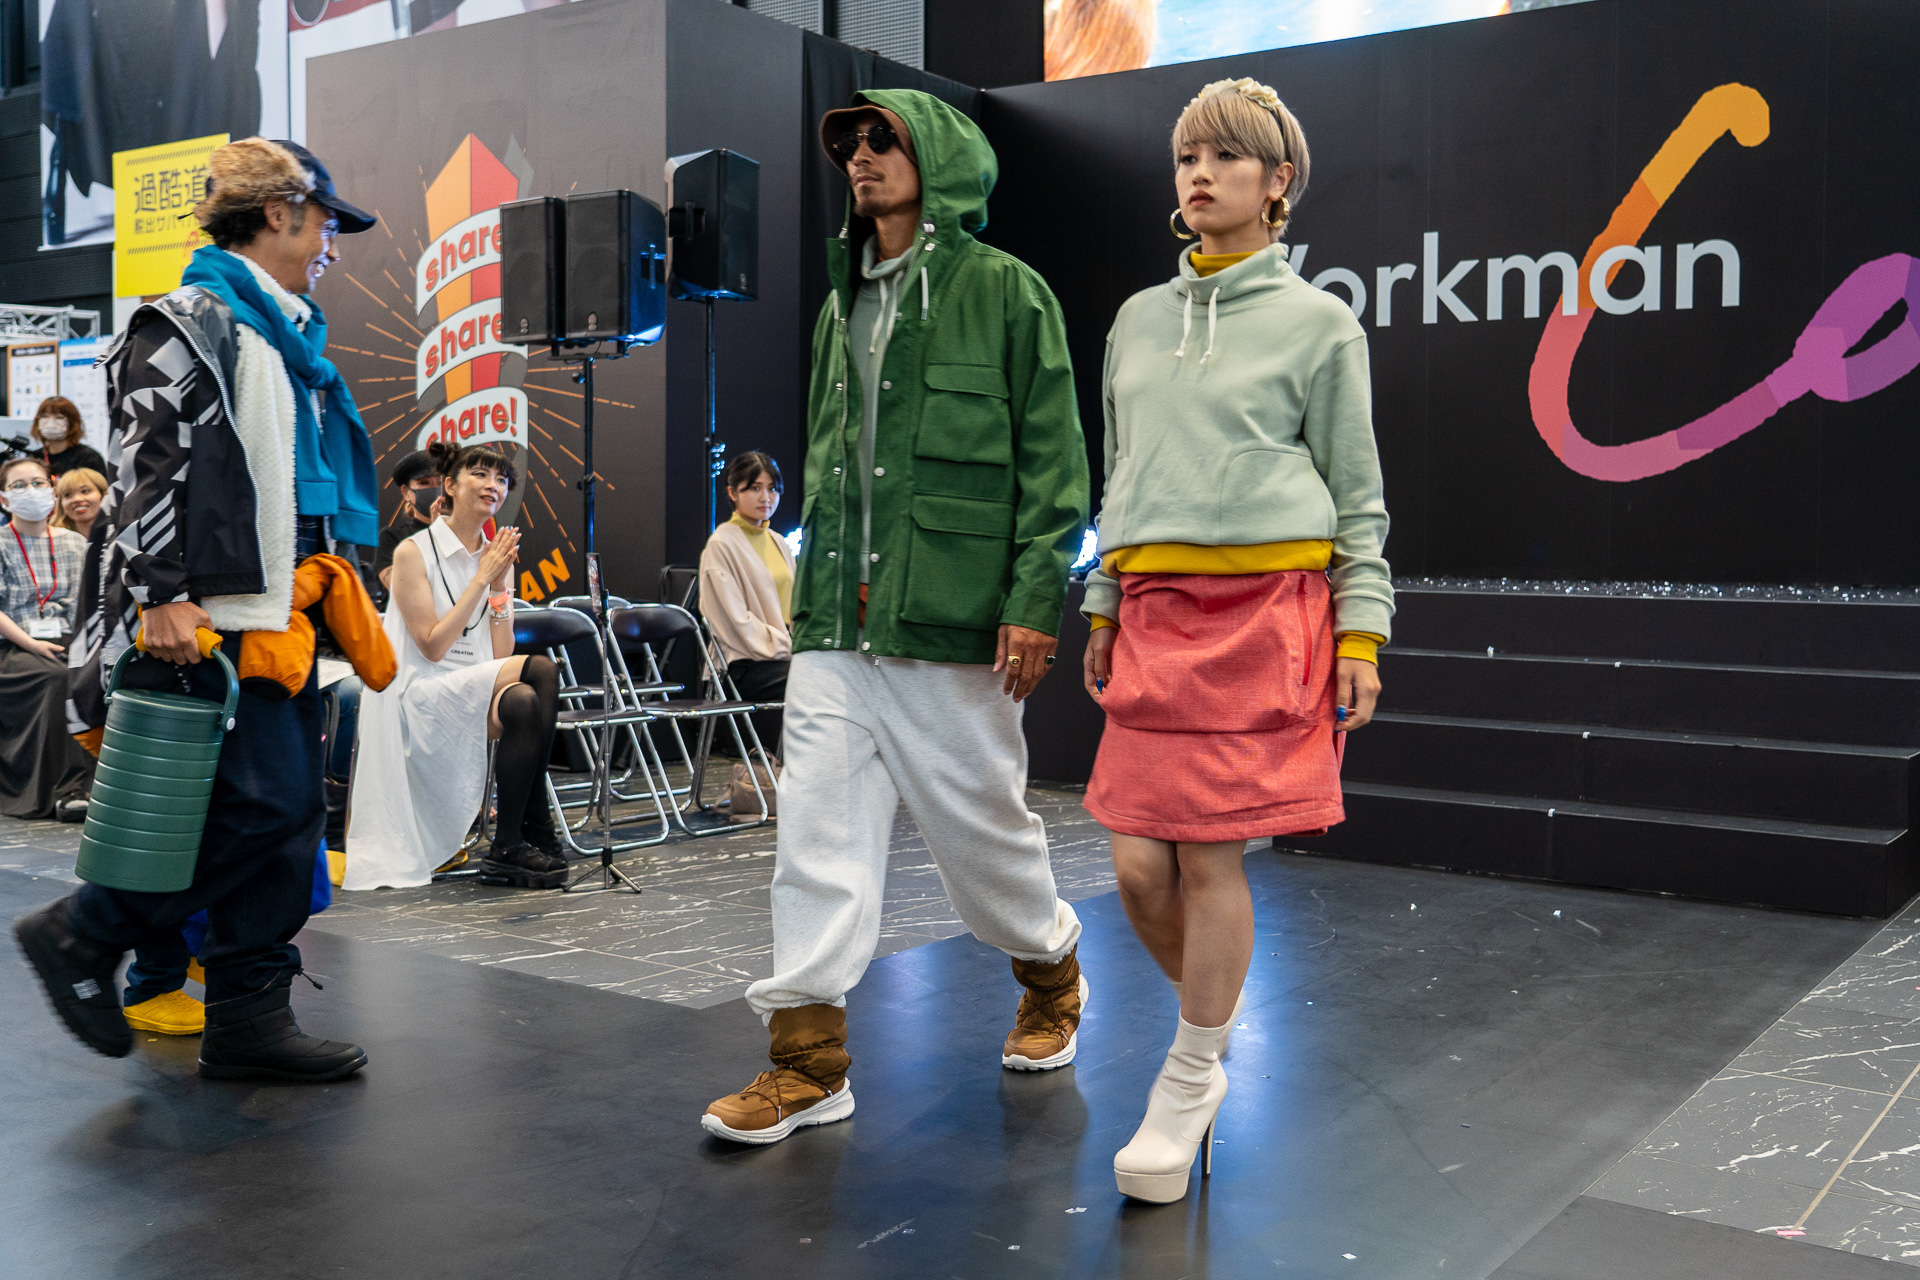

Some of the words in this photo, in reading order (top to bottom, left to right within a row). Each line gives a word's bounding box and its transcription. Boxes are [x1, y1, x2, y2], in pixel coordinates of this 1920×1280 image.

[425, 222, 502, 292] share
[1288, 231, 1741, 328] orkman
[425, 311, 502, 379] share
